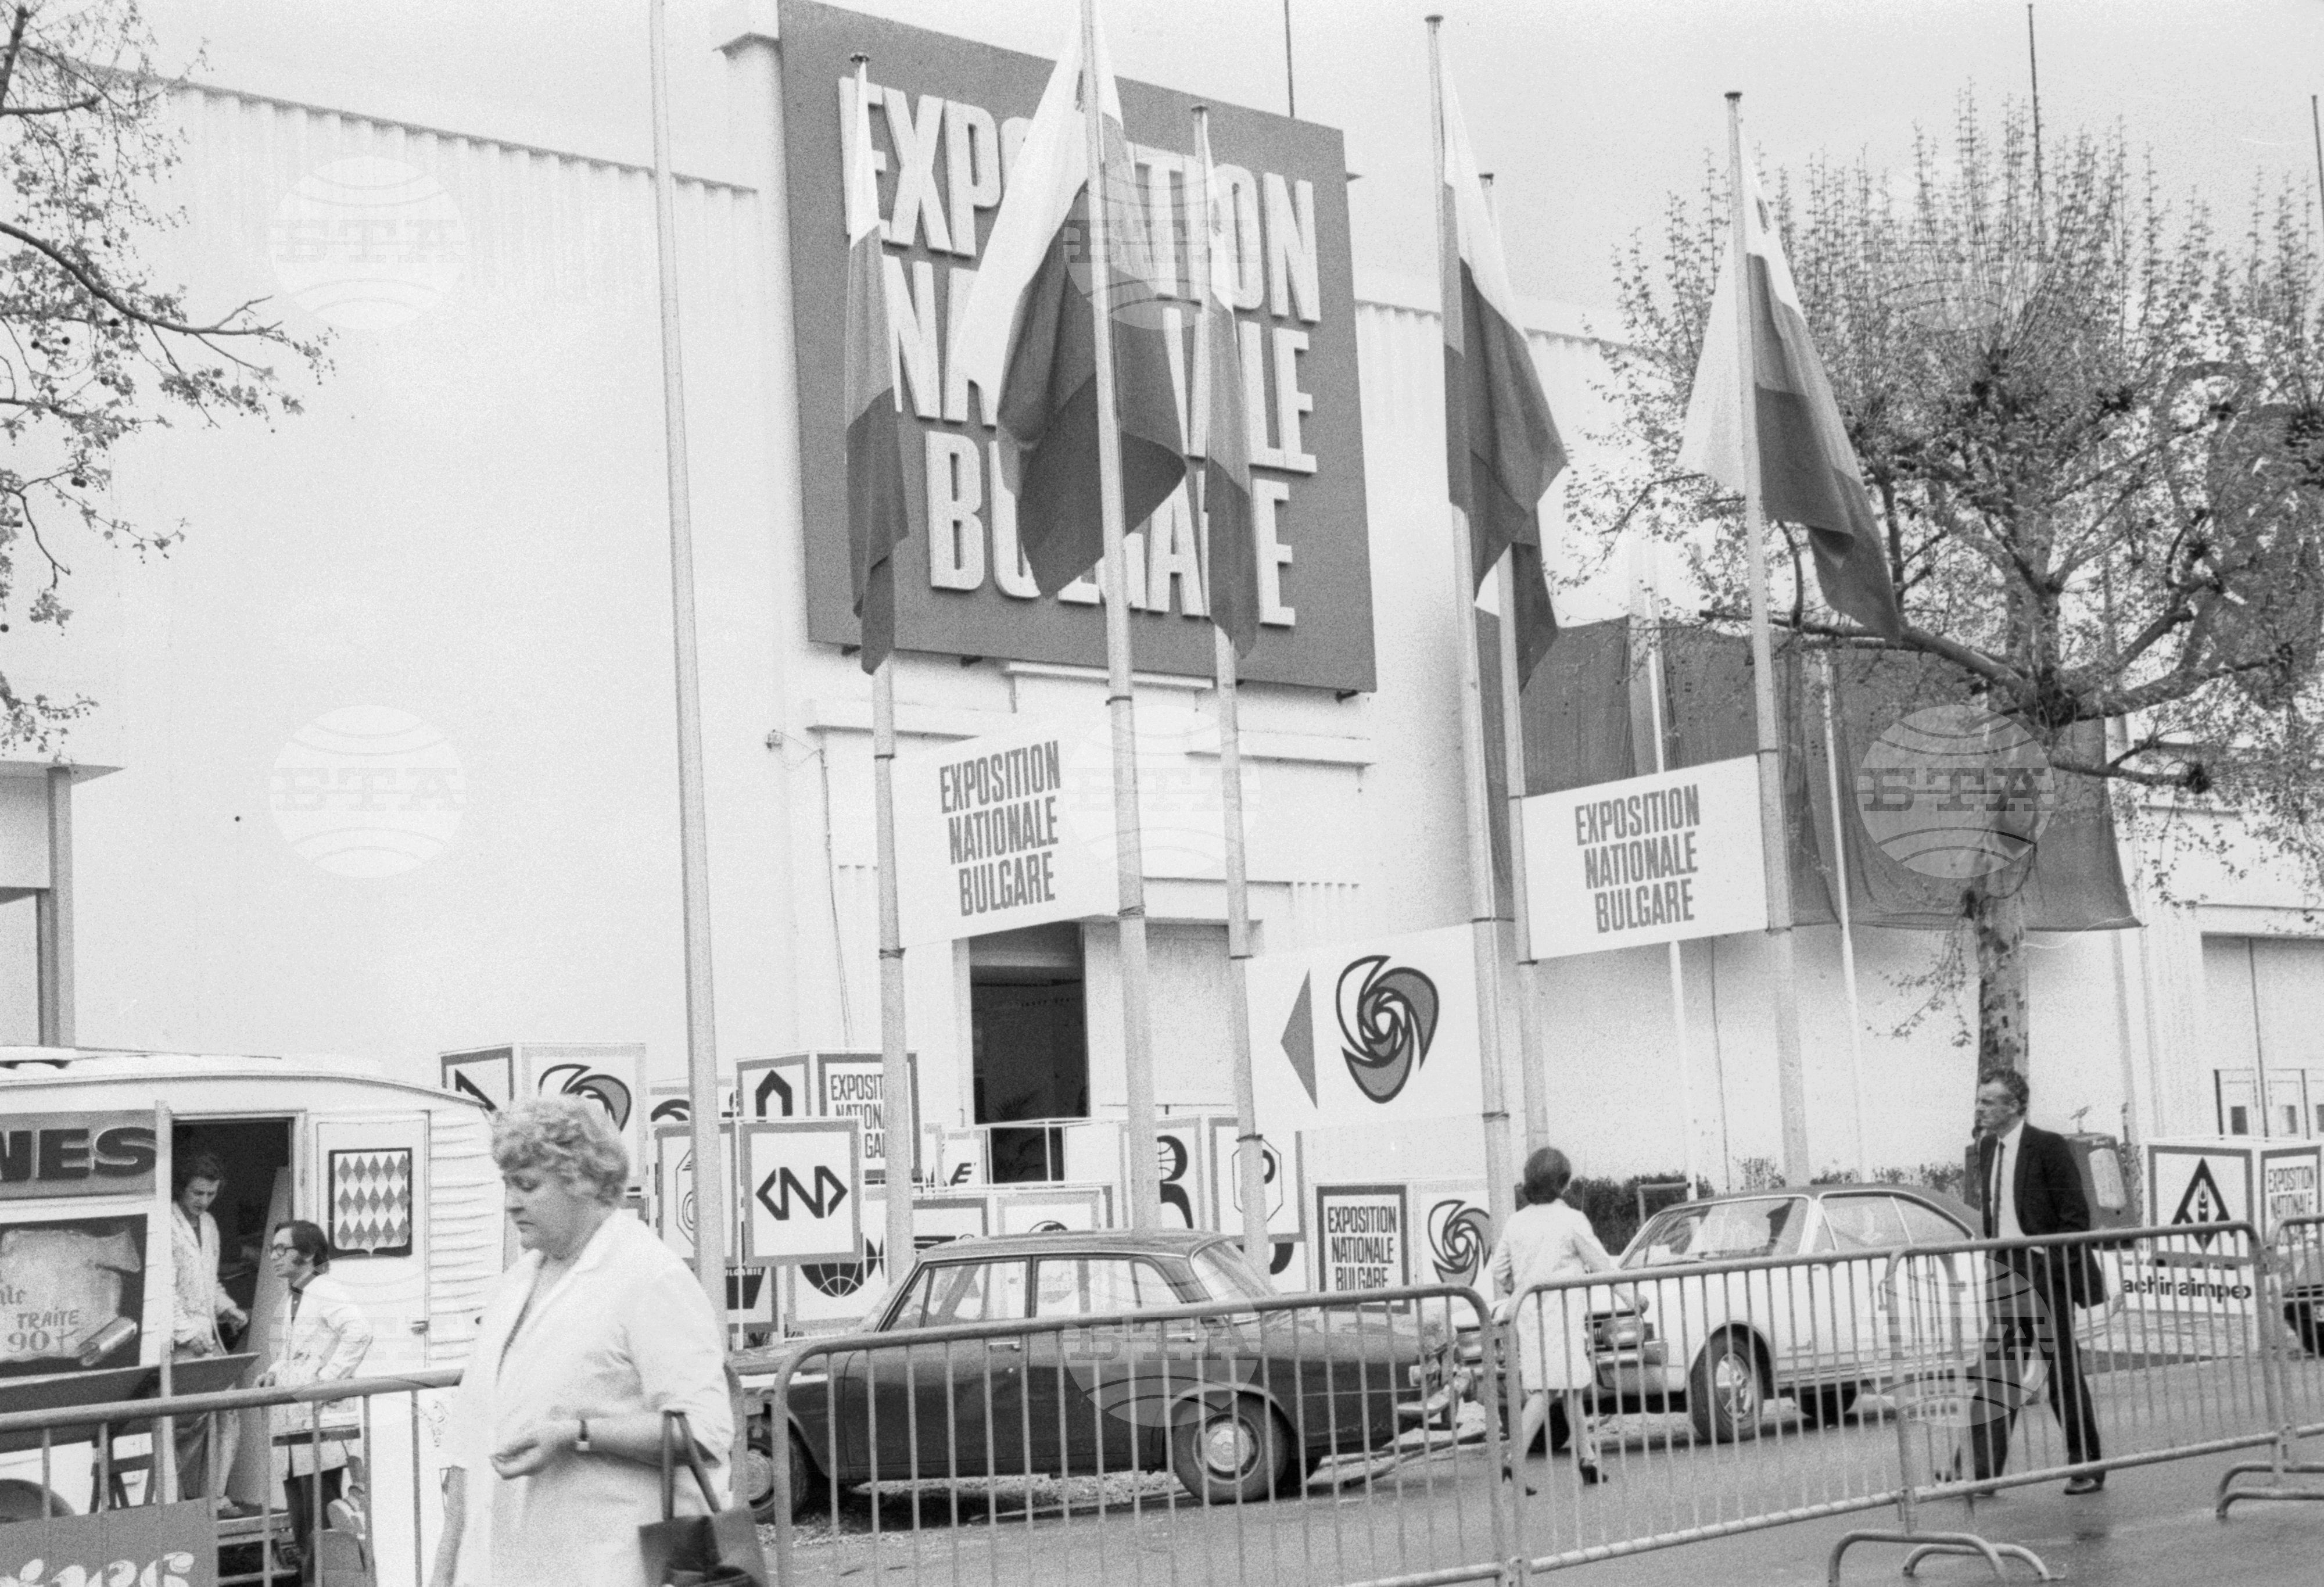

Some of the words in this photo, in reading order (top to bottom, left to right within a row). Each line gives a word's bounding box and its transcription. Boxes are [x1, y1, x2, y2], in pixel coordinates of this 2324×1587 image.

[838, 76, 1321, 323] EXPTION
[939, 740, 1061, 814] EXPOSITION
[948, 796, 1059, 865] NATIONALE
[1575, 784, 1700, 846] EXPOSITION
[959, 851, 1056, 916] BULGARE
[1584, 831, 1698, 889] NATIONALE
[1594, 878, 1695, 934] BULGARE
[830, 1074, 884, 1101] EXPOSIT
[1328, 1206, 1397, 1233] EXPOSITION
[1332, 1236, 1394, 1263] NATIONALE
